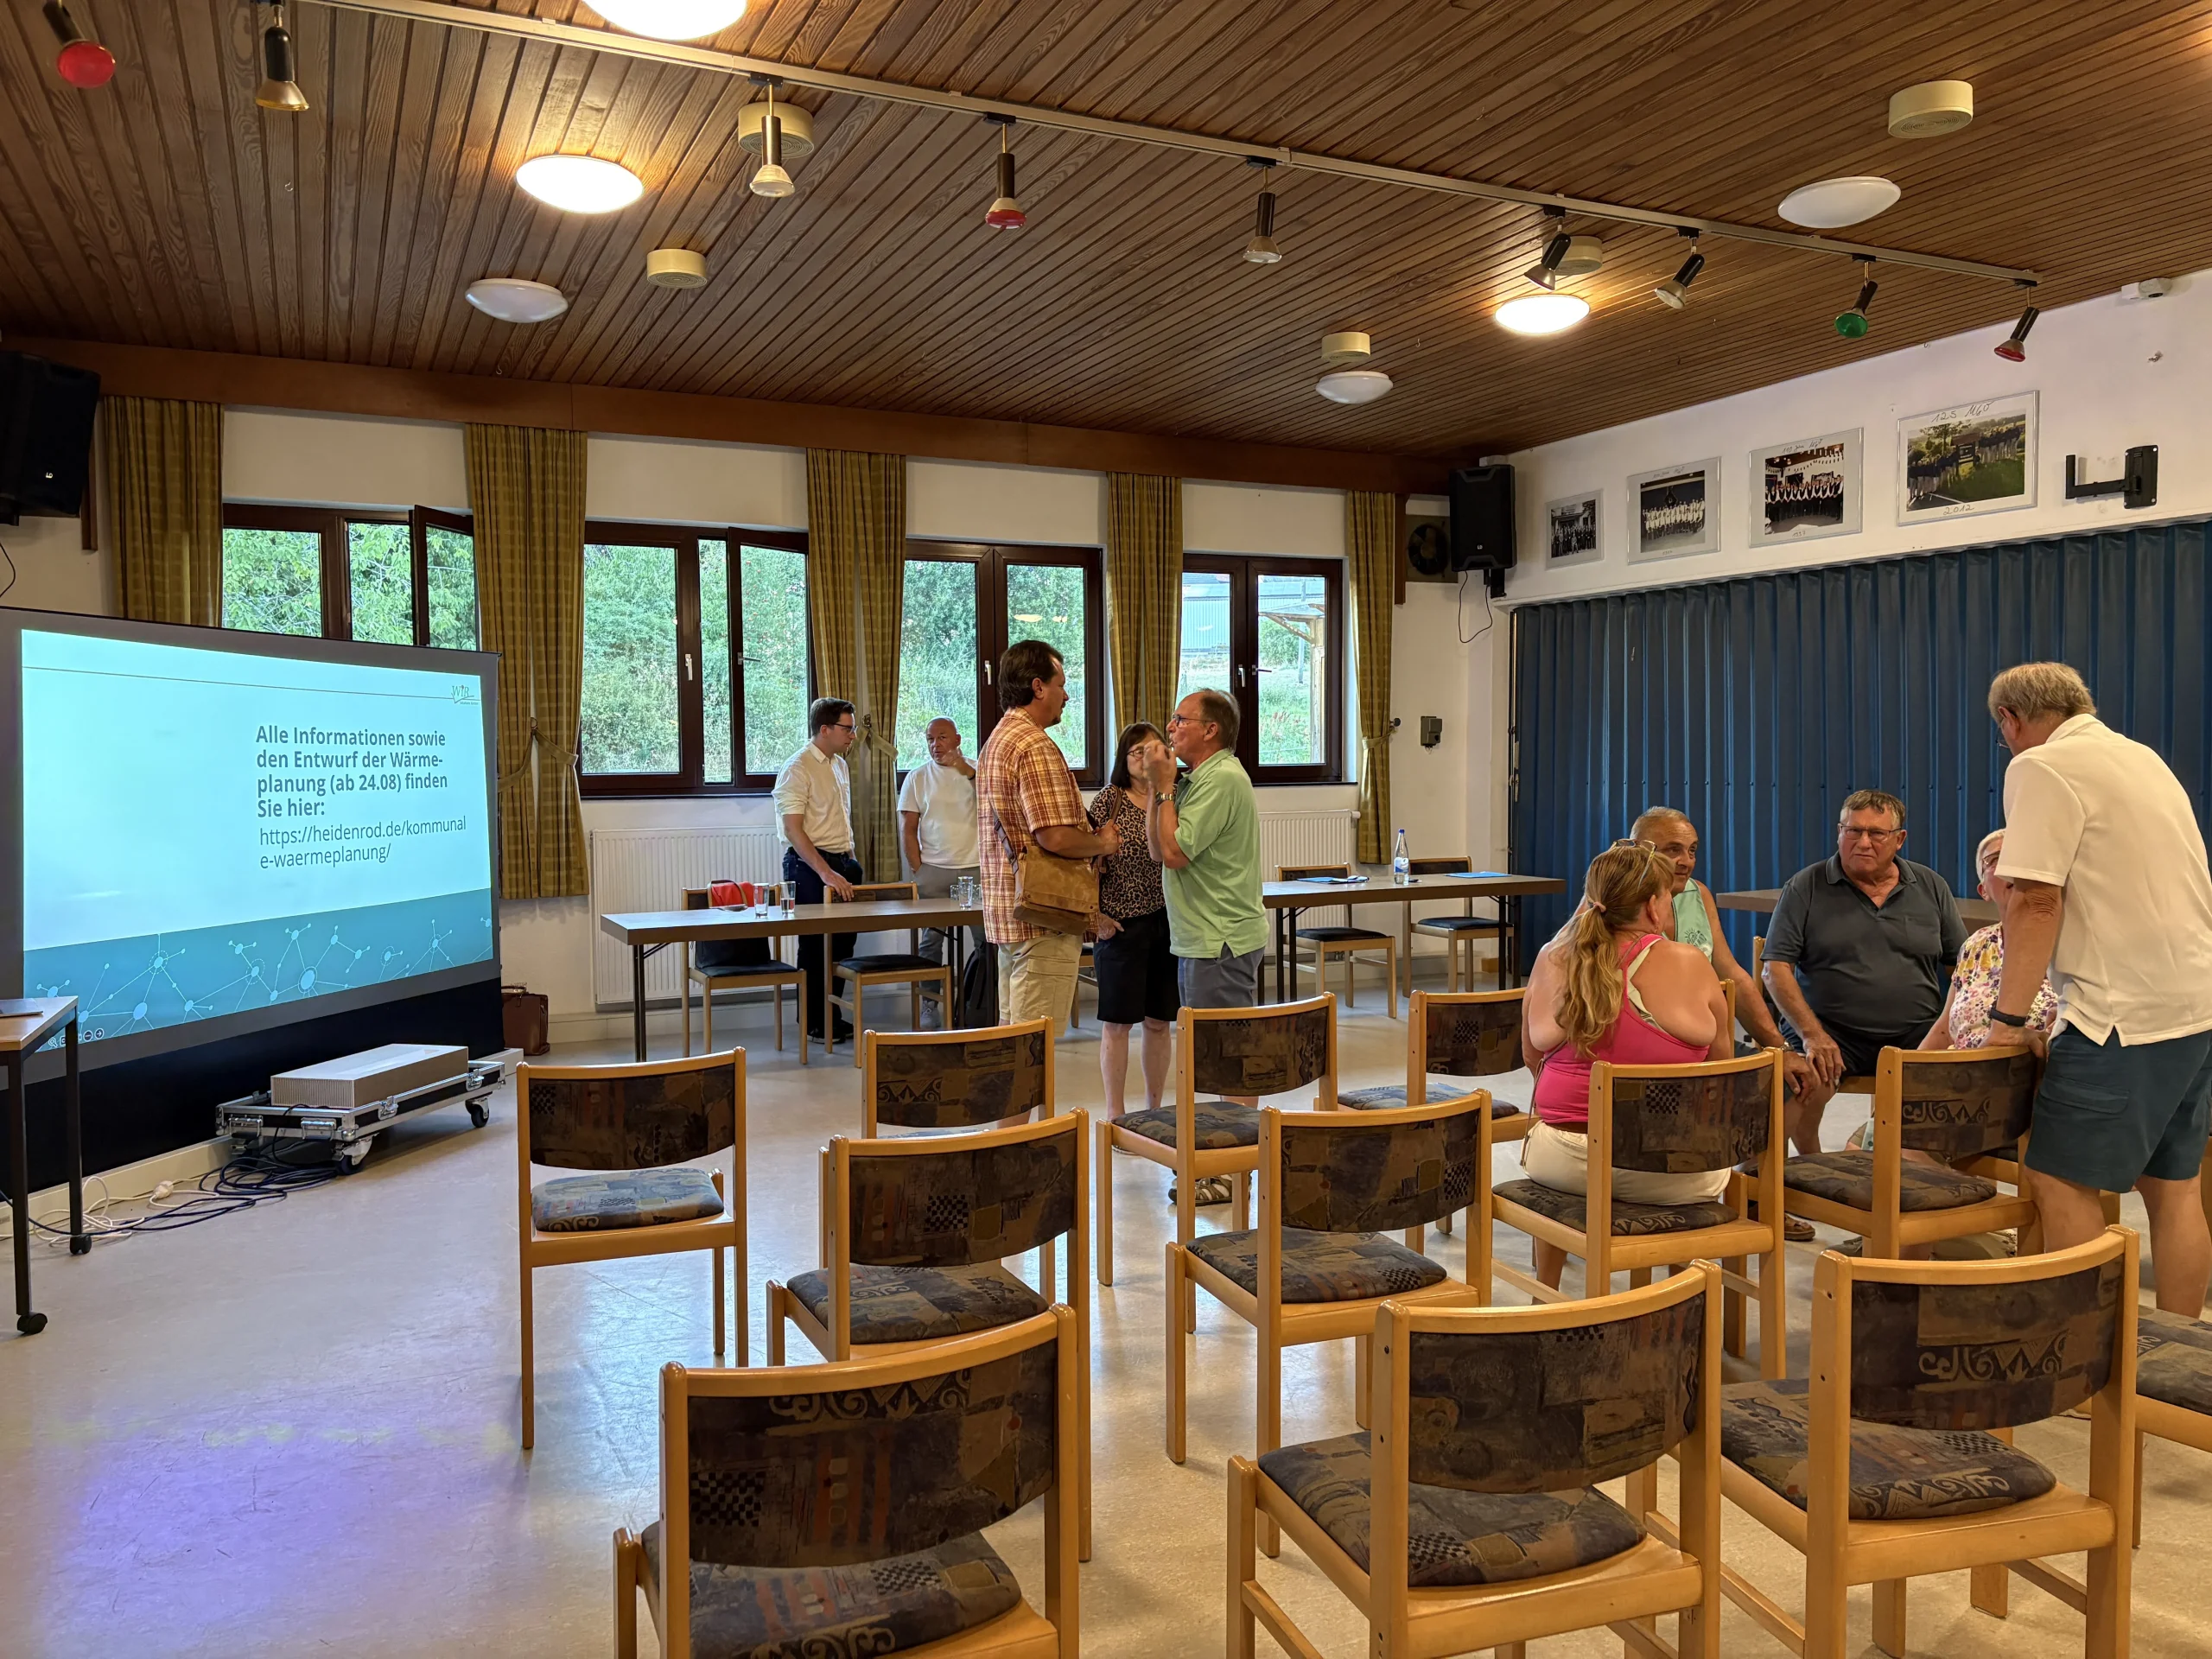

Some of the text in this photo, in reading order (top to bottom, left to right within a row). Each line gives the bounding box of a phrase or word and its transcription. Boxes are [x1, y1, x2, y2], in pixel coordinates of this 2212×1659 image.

[1931, 410, 1957, 423] 125
[1943, 504, 1975, 516] 2012
[256, 725, 446, 747] Alle Informationen sowie
[257, 749, 443, 768] den Entwurf der Wärme-
[257, 772, 448, 798] planung (ab 24.08) finden
[257, 797, 326, 817] Sie hier:
[259, 815, 467, 849] https://heidenrod.de/kommunal
[259, 843, 391, 869] e-waermeplanung/
